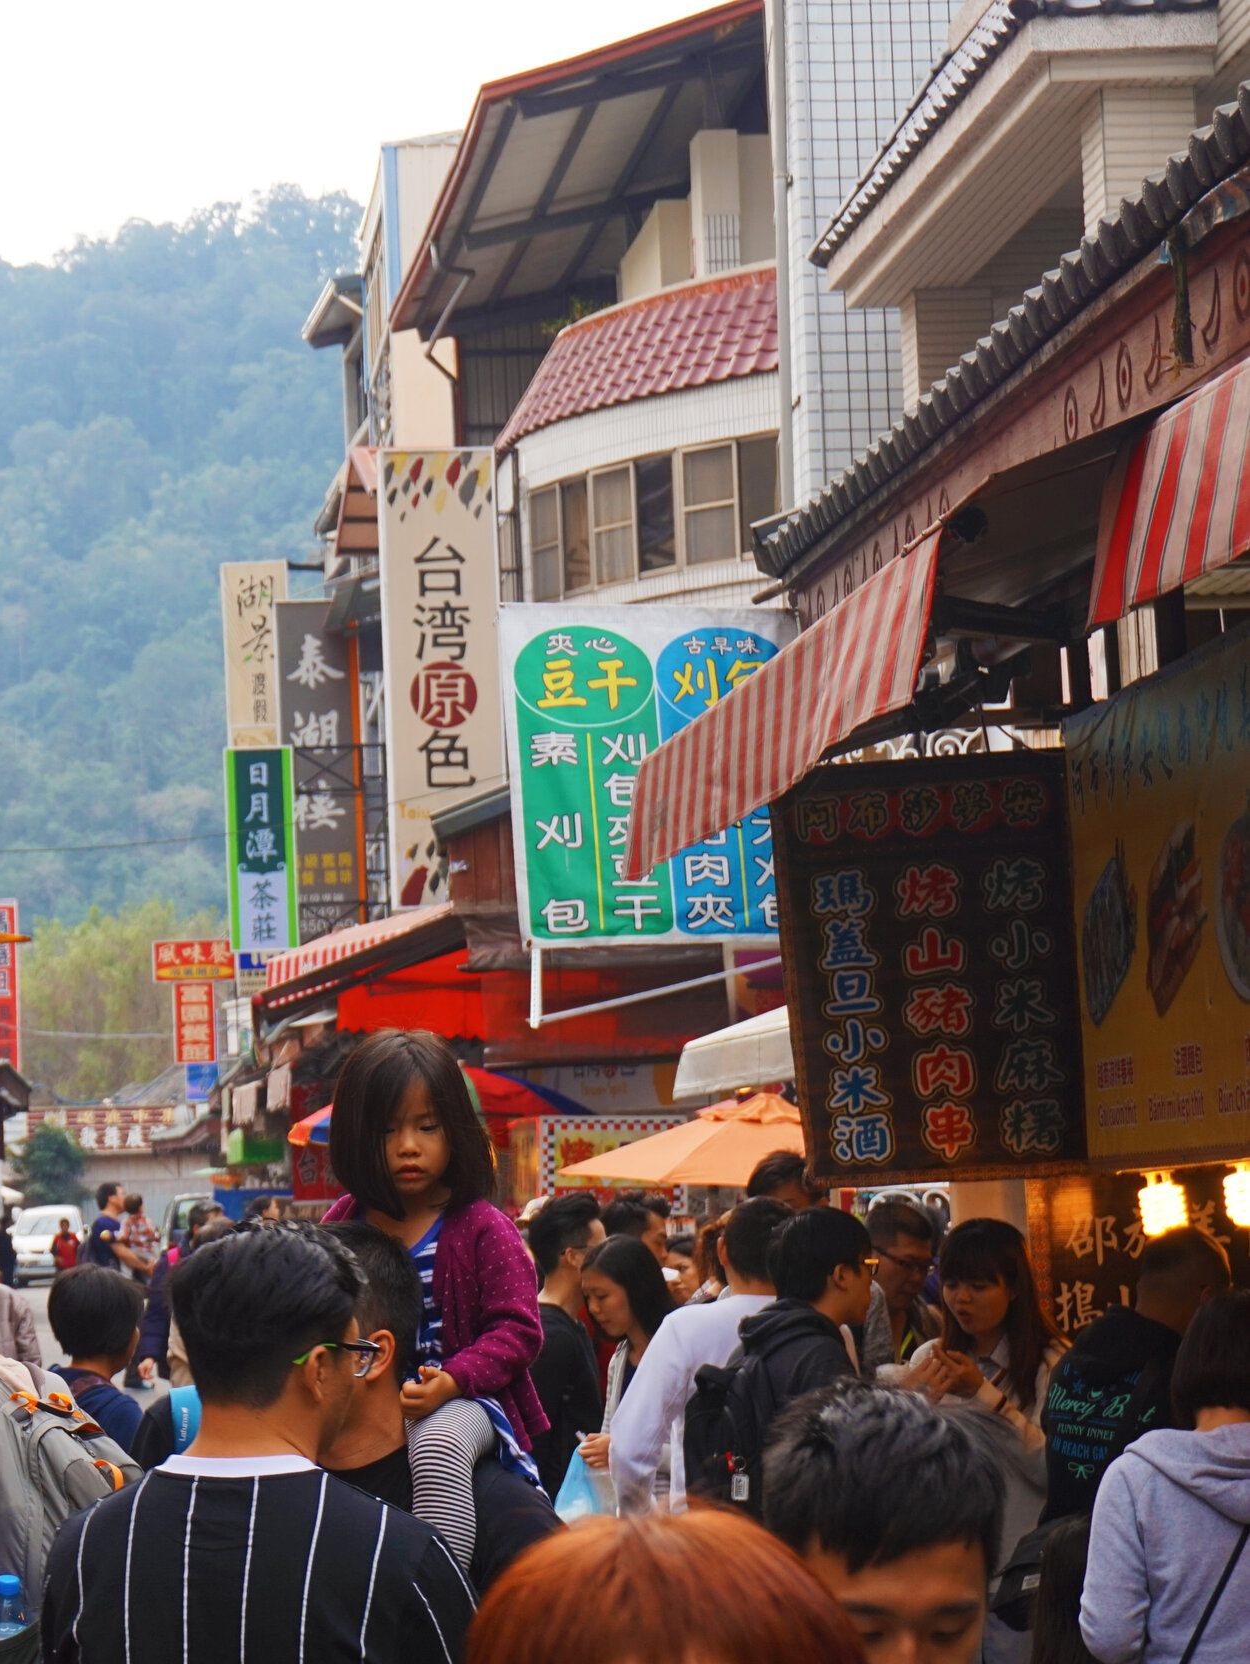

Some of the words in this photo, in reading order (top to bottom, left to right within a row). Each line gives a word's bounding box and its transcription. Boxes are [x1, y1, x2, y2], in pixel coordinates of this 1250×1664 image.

[411, 535, 477, 788] 台湾原色
[546, 632, 618, 657] 夾心
[683, 636, 760, 656] 古早味
[536, 658, 638, 711] 豆干
[245, 762, 278, 863] 日月潭
[684, 829, 735, 929] 肉夾
[814, 868, 892, 1163] 瑪蓋旦小米酒
[898, 864, 975, 1158] 烤山豬肉串
[984, 858, 1066, 1154] 烤小米麻糬
[1048, 1382, 1097, 1421] Mercy
[1057, 1422, 1085, 1437] FUNNY
[1062, 1440, 1089, 1459] REACH
